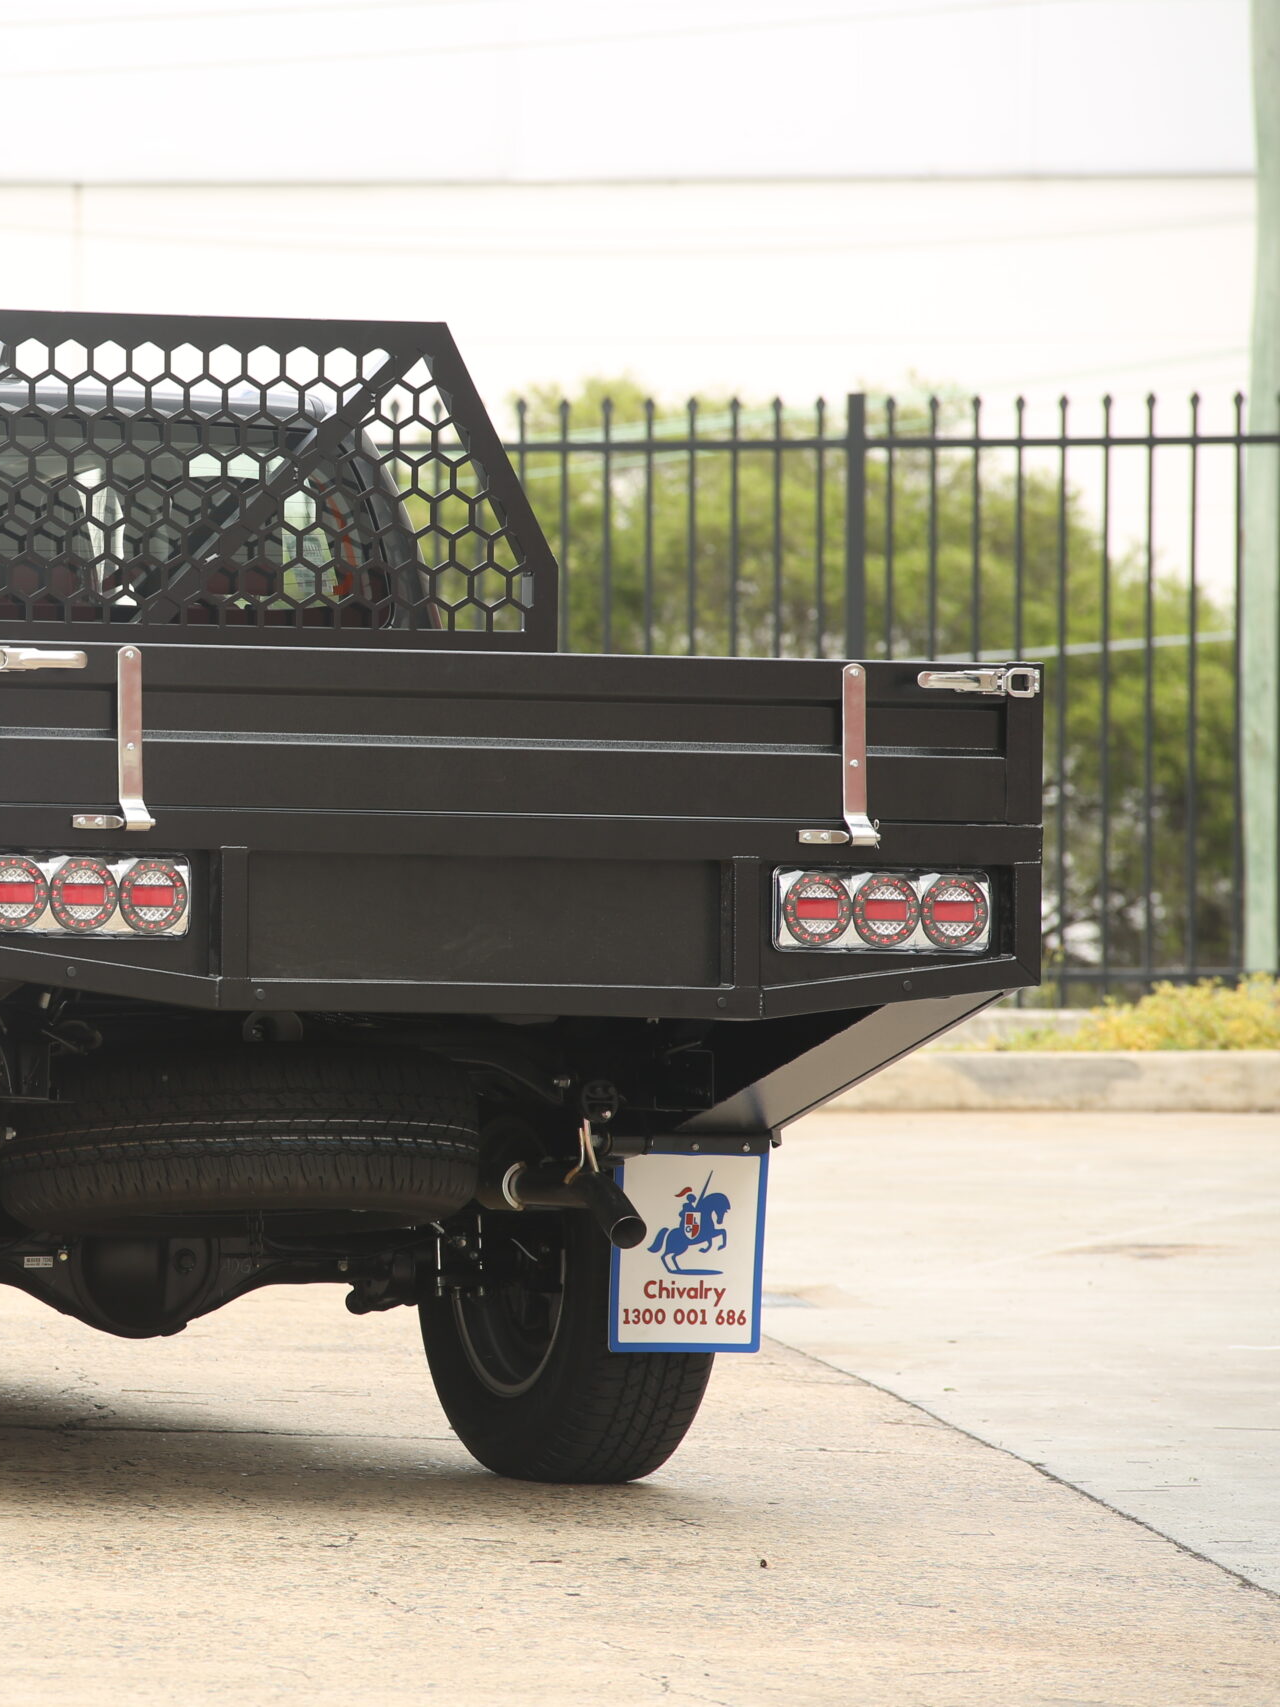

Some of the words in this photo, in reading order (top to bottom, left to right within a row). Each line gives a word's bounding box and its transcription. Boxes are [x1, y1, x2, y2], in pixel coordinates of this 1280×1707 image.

[643, 1280, 726, 1307] Chivalry
[623, 1308, 666, 1325] 1300
[673, 1309, 707, 1325] 001
[715, 1310, 747, 1326] 686
